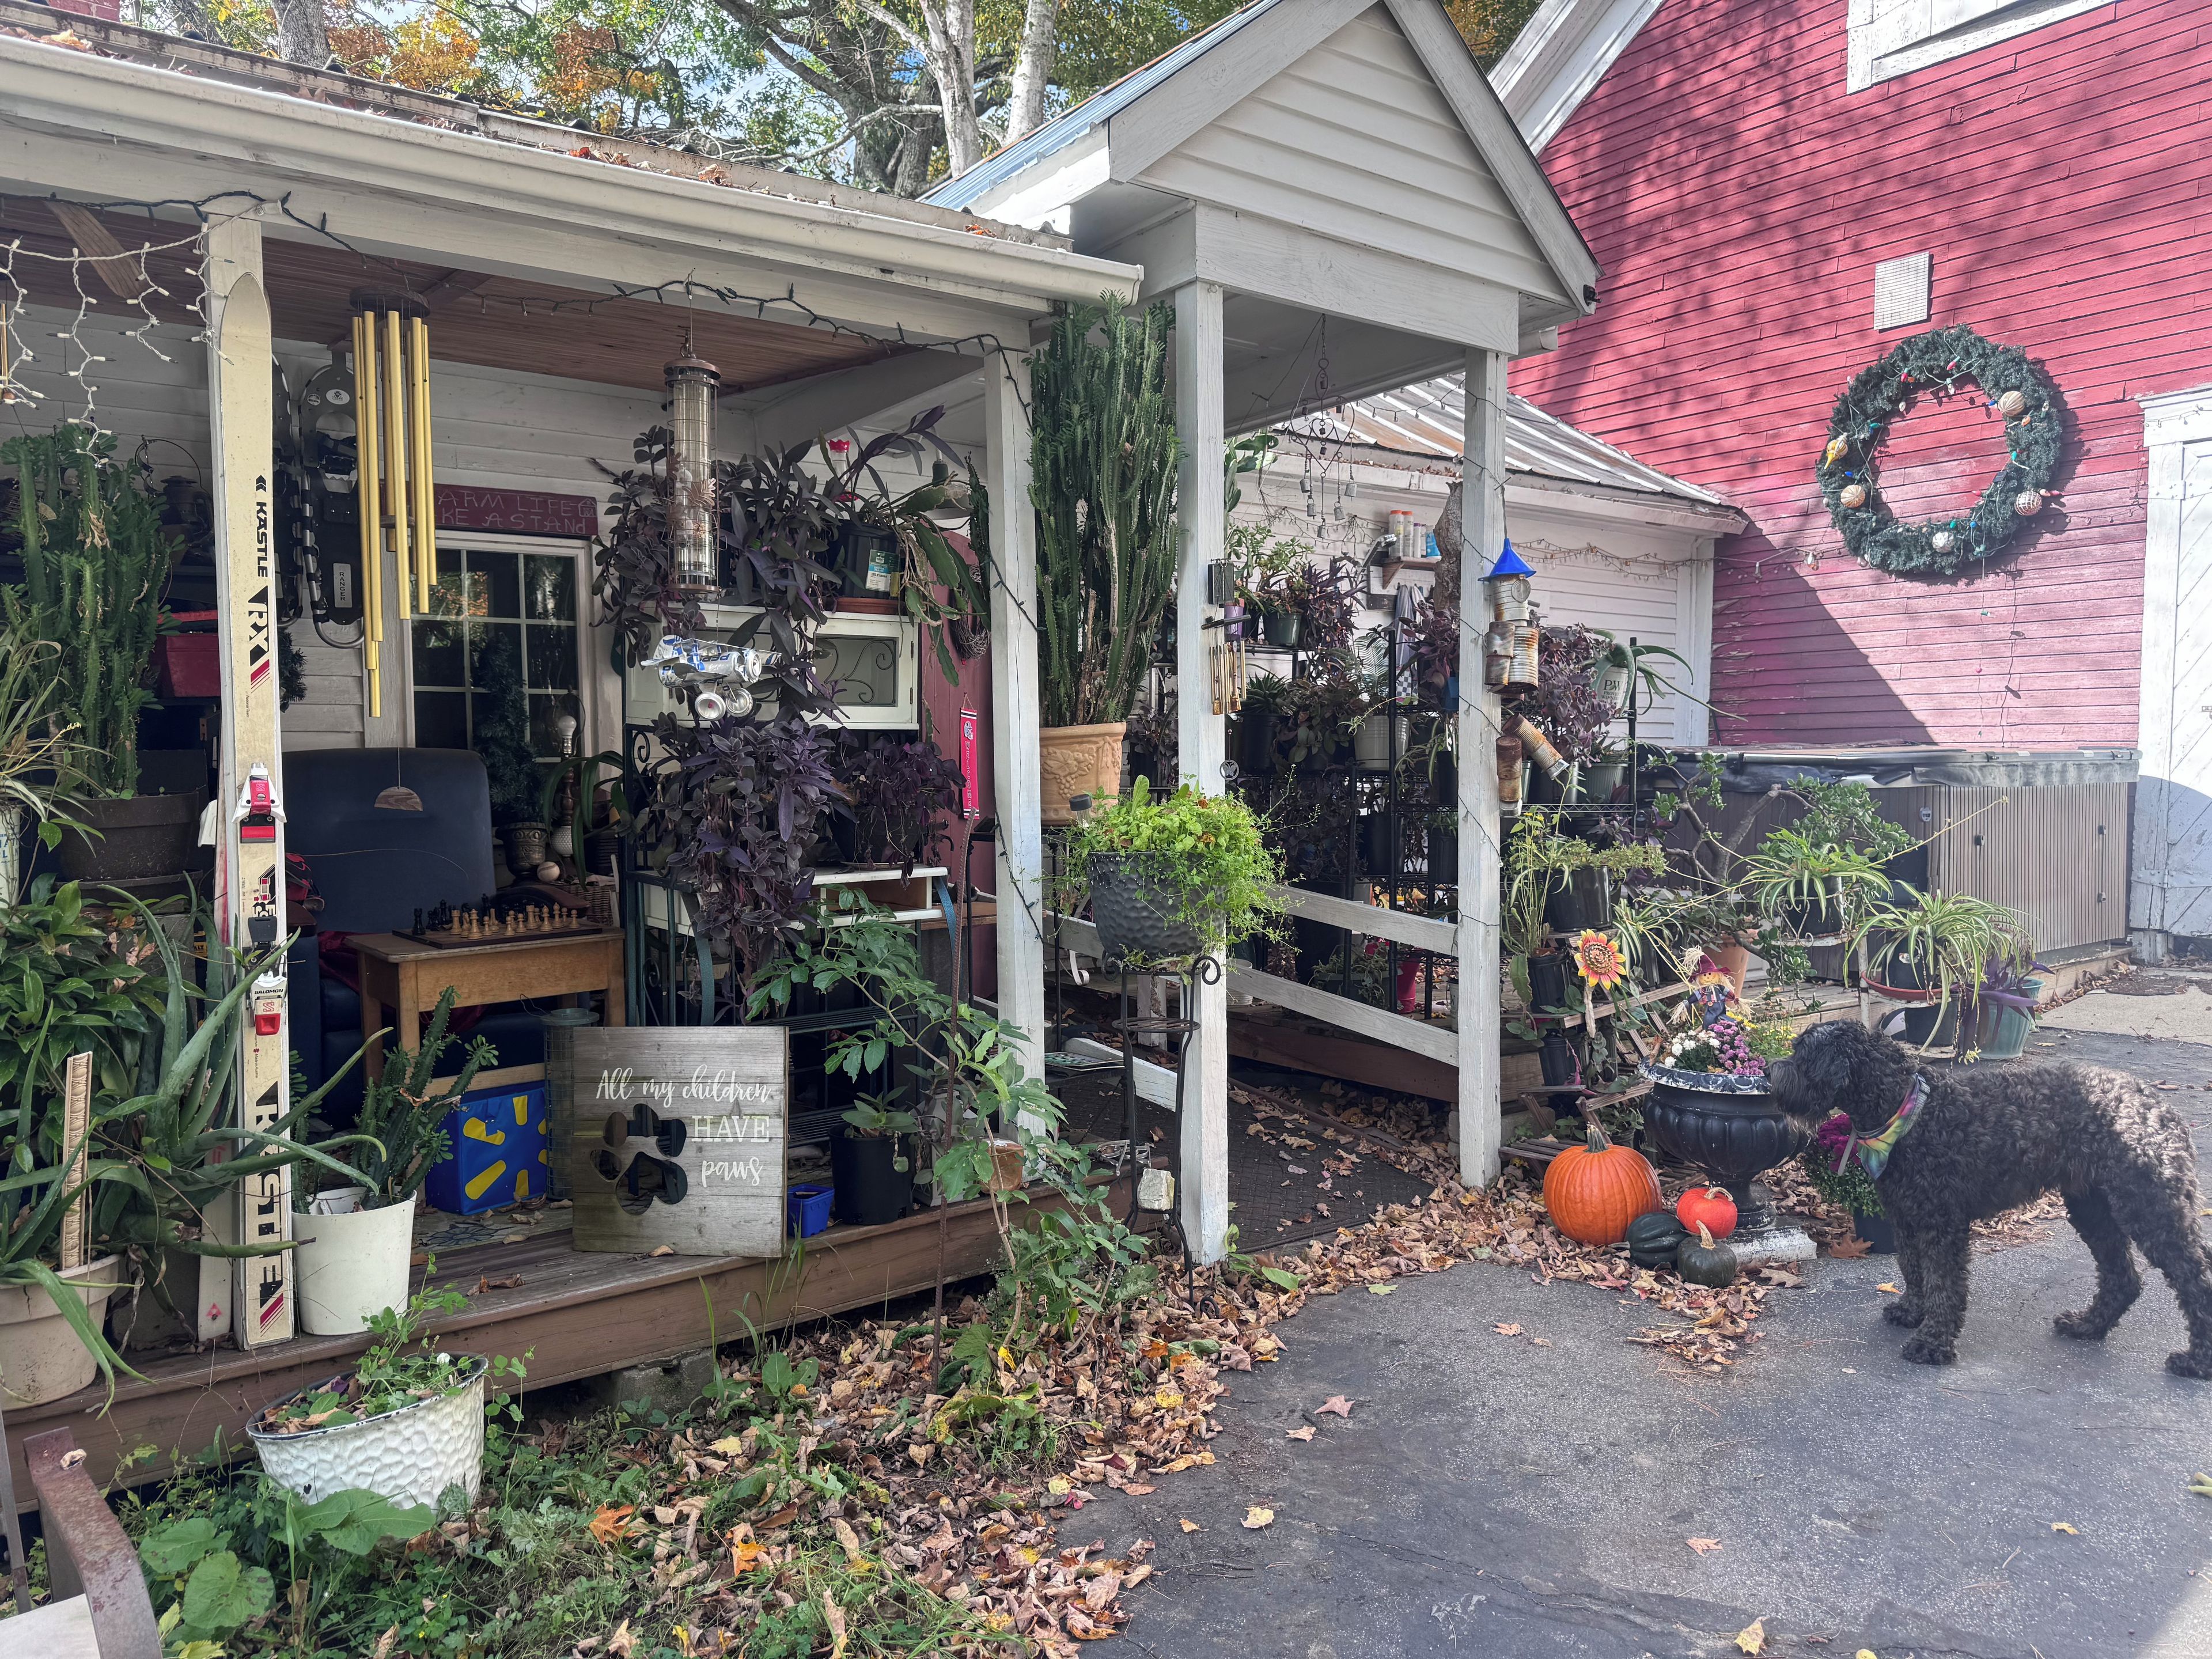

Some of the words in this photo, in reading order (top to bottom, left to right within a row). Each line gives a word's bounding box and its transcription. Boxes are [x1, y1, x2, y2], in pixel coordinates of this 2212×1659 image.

[438, 491, 505, 509] ARM
[517, 496, 573, 516] LIFE
[442, 507, 470, 525] KE
[256, 501, 268, 578] KASTLE
[596, 1067, 635, 1100] All
[642, 1078, 675, 1108] my
[682, 1064, 771, 1103] children
[691, 1115, 770, 1142] HAVE
[701, 1157, 763, 1188] paws
